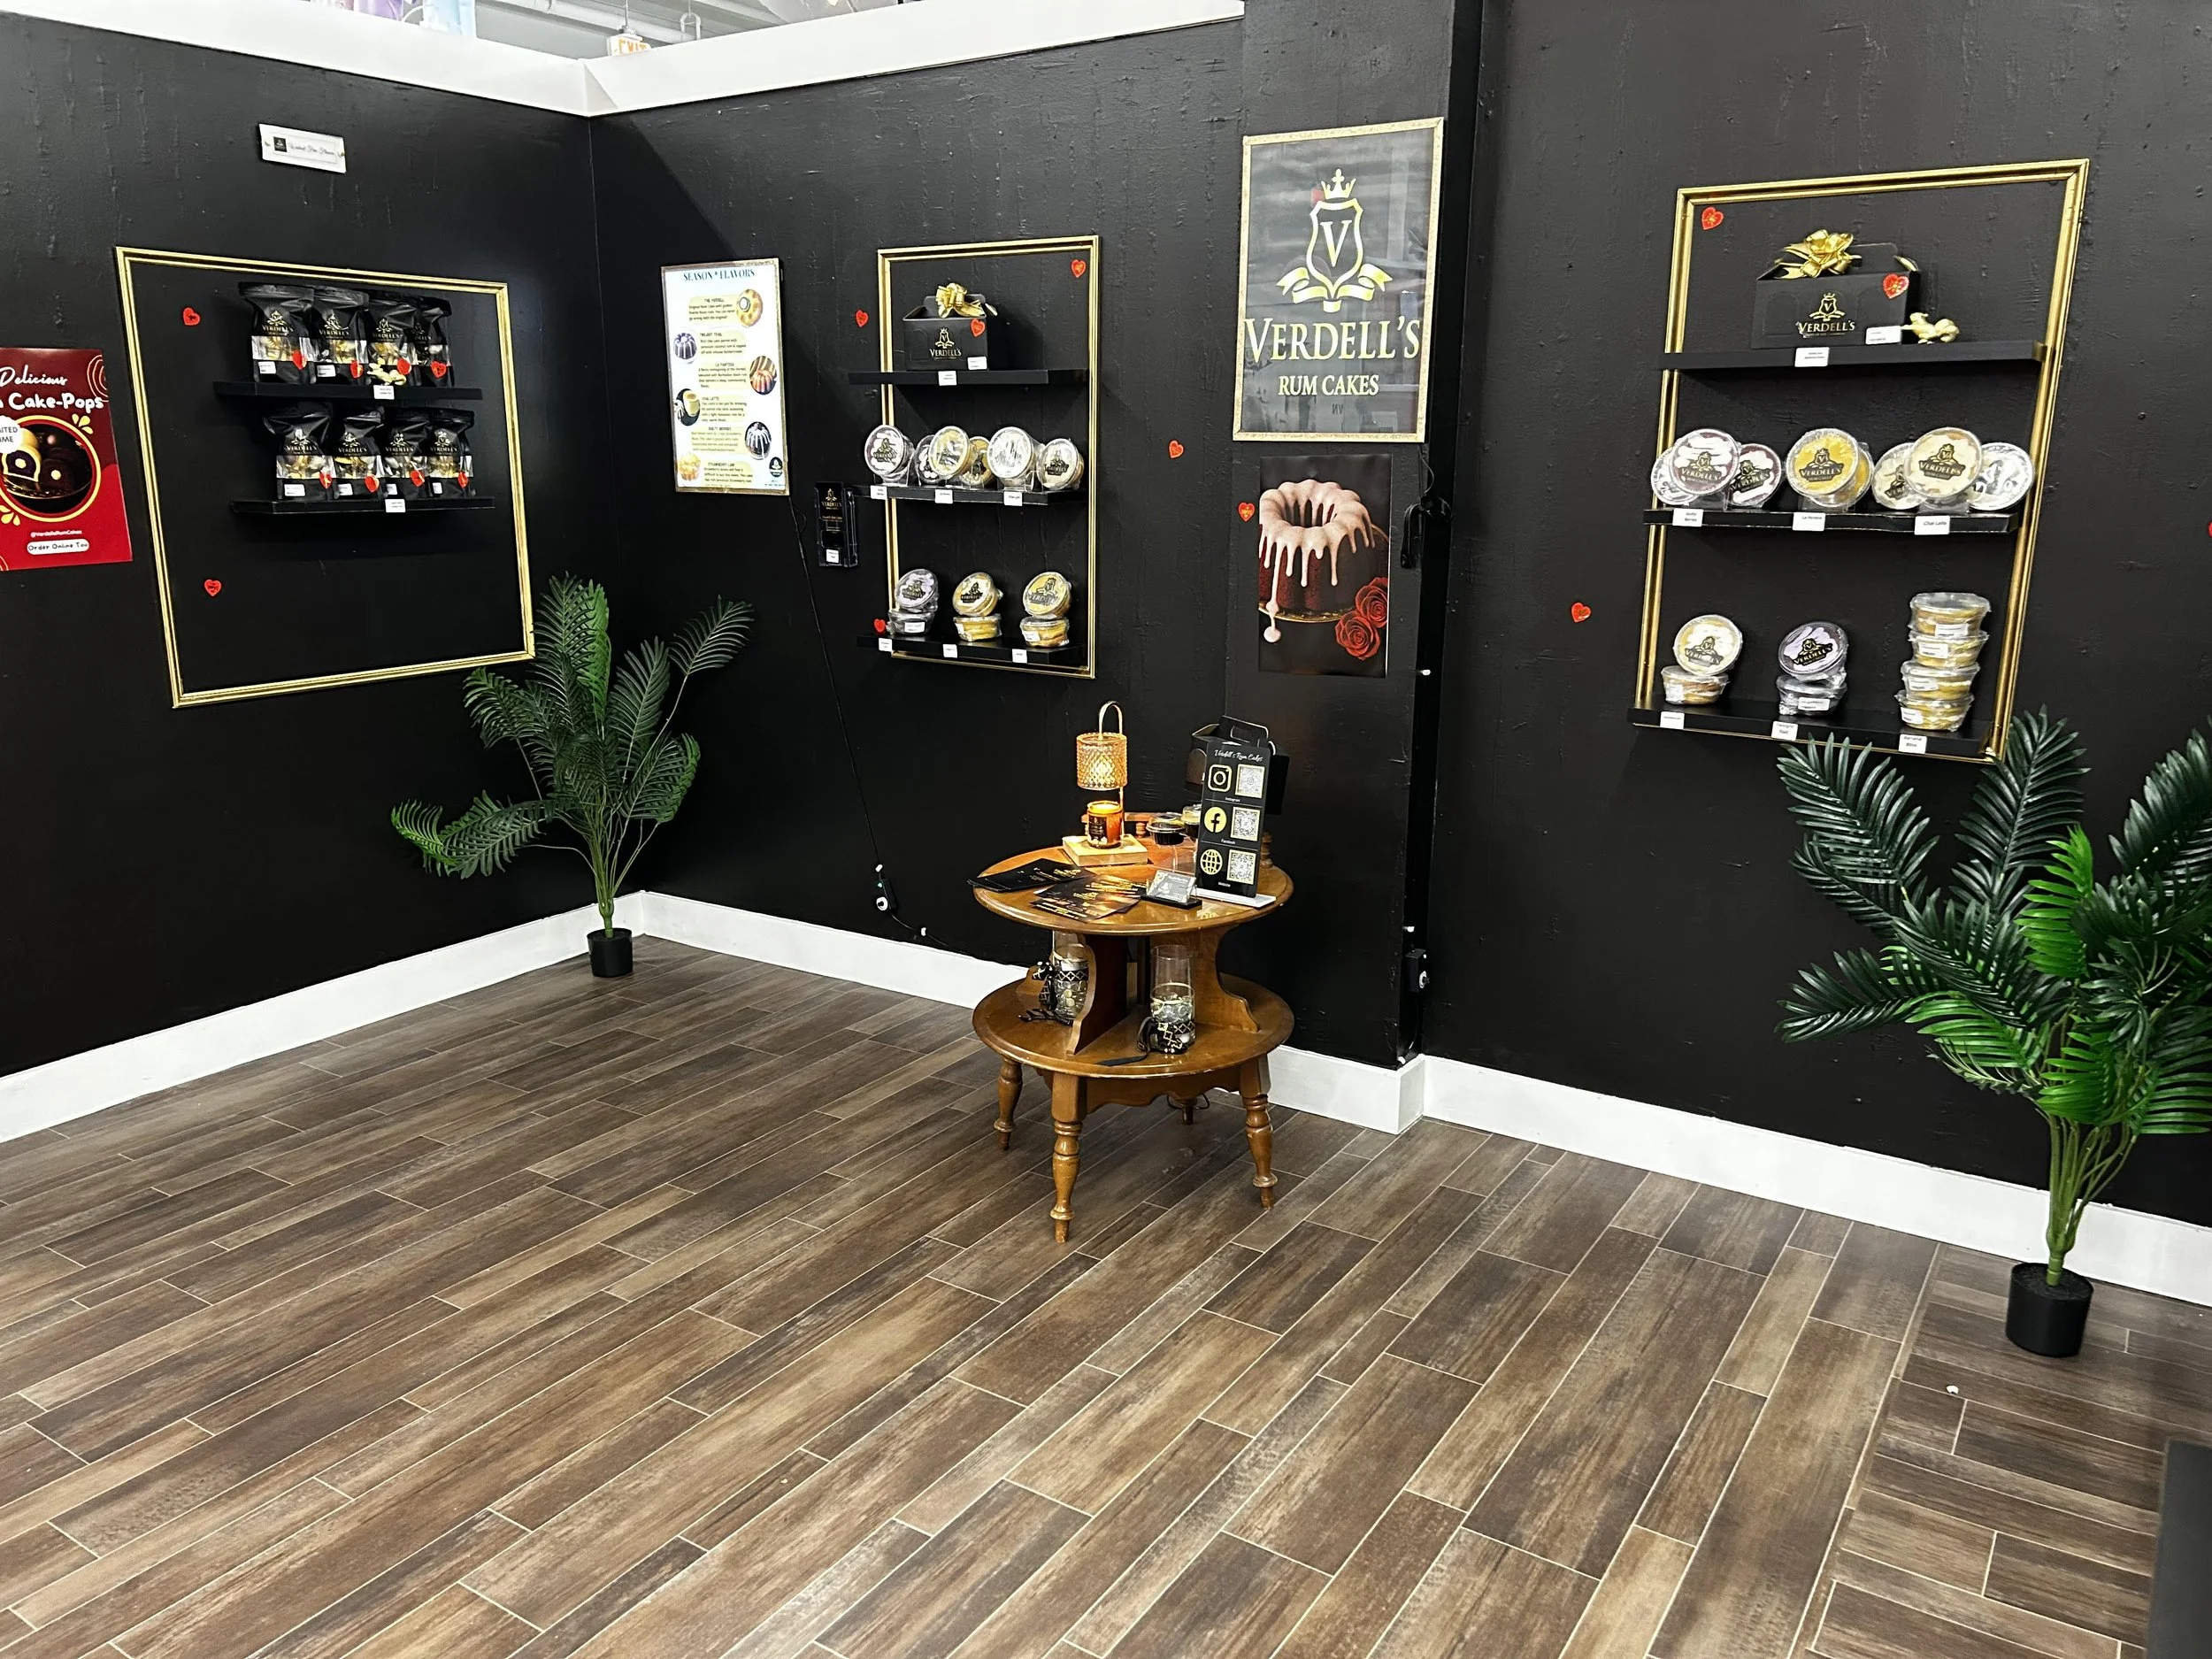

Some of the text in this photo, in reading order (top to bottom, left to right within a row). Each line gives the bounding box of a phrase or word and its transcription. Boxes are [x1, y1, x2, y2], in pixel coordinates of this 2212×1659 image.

[684, 269, 755, 281] SEASON FLAVORS
[1799, 319, 1855, 333] VERDELL'S
[1243, 316, 1421, 364] VERDELL'S
[929, 348, 962, 357] VERDELL'S
[0, 365, 68, 388] Delicious
[1278, 374, 1379, 396] RUM CAKES
[8, 392, 104, 414] Cake-Pops
[1801, 468, 1841, 477] VERDELL'S
[1793, 648, 1832, 664] VERDELL'S
